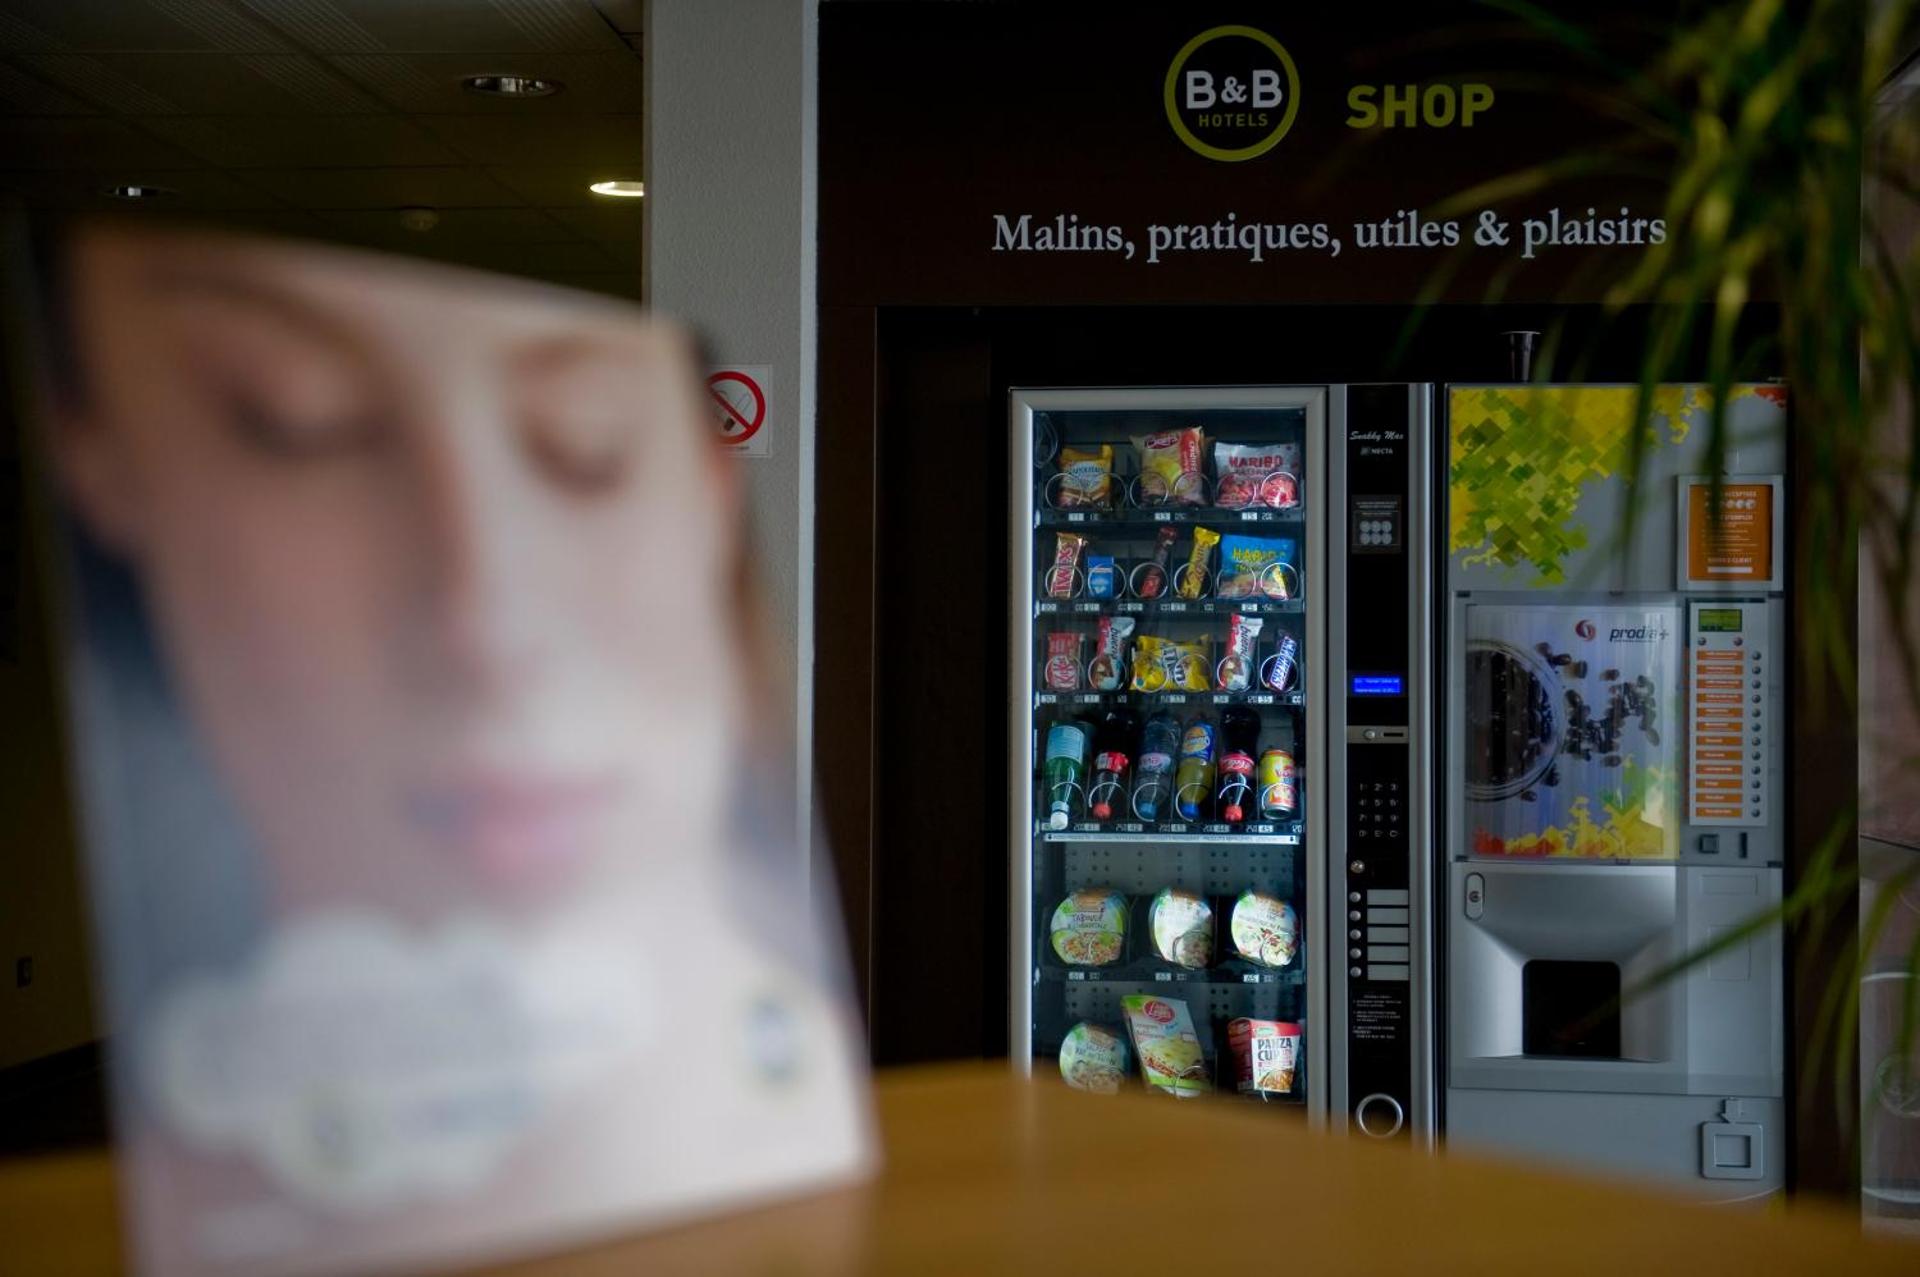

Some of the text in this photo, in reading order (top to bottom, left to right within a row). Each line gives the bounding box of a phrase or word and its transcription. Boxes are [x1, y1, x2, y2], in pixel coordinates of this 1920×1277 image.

[1186, 70, 1282, 109] B&B
[1346, 83, 1496, 130] SHOP
[1198, 113, 1269, 127] HOTELS
[992, 207, 1667, 263] Malins, pratiques, utiles & plaisirs
[1229, 455, 1283, 468] HARIBO
